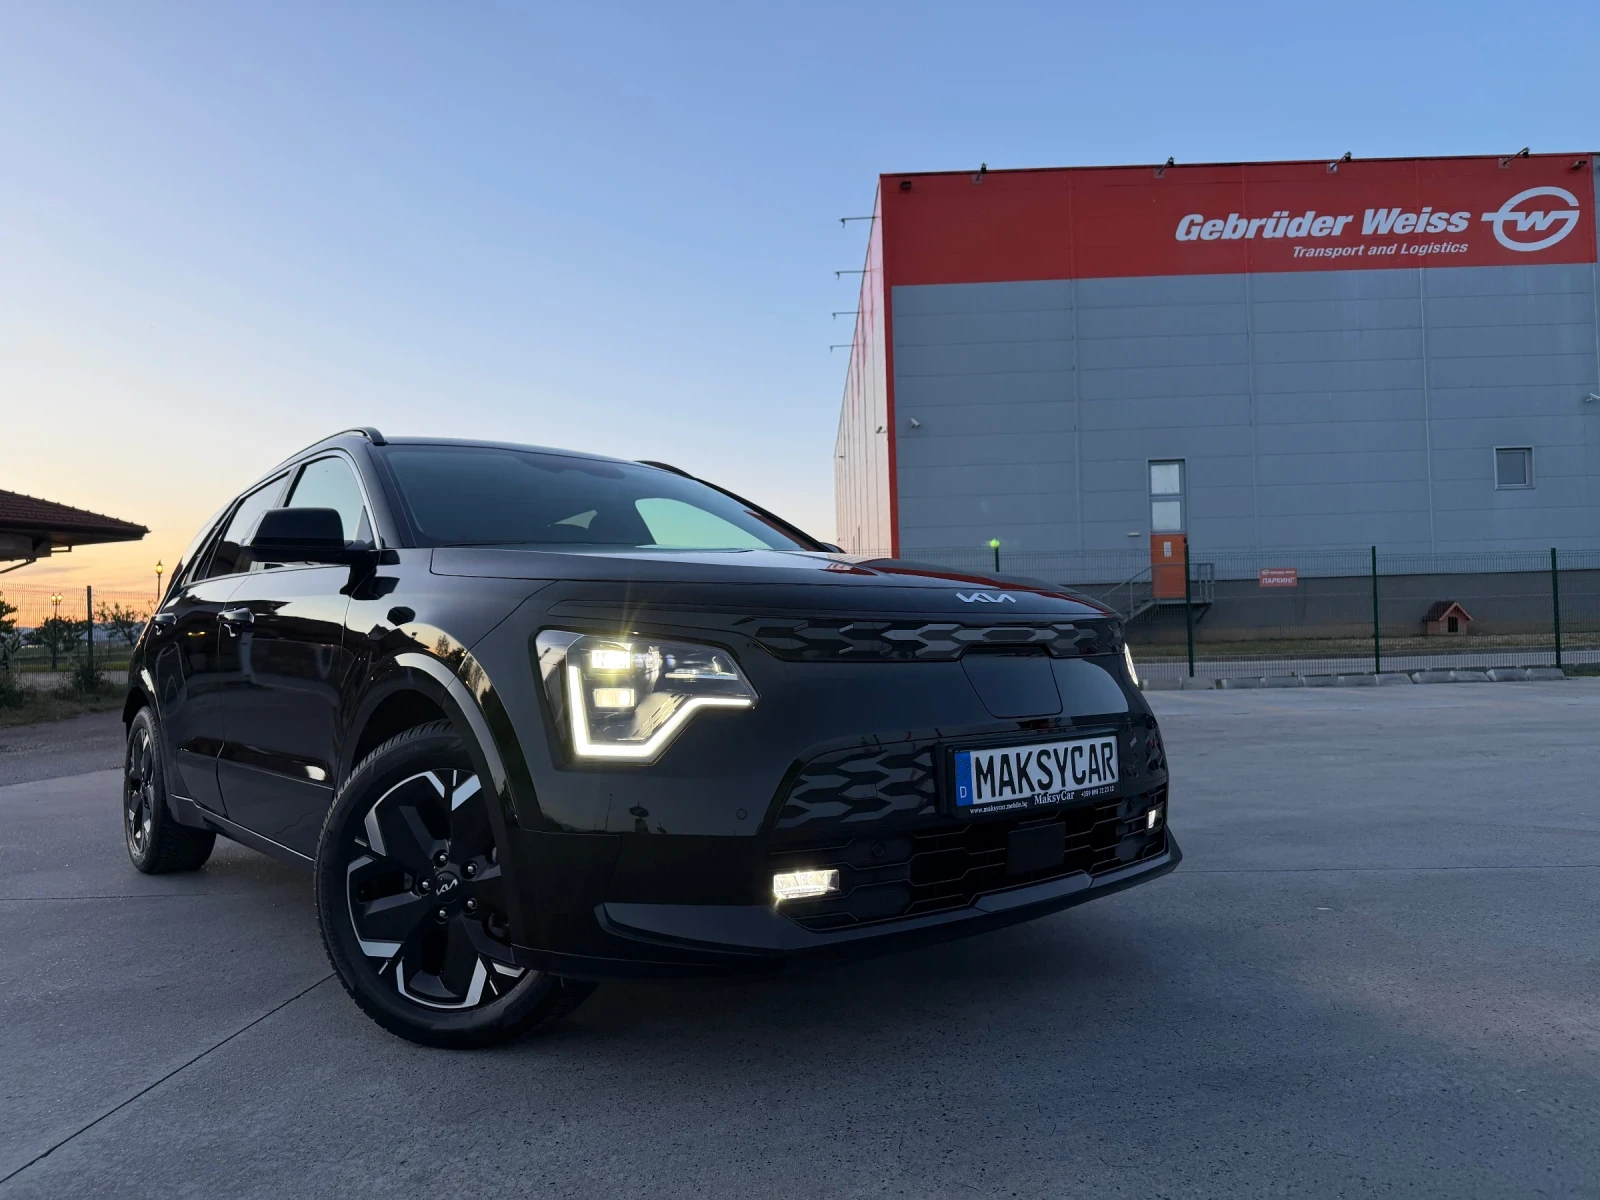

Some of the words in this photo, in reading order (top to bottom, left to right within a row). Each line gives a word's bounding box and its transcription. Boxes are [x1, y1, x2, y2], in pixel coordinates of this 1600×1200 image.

[1174, 210, 1352, 242] Gebrüder
[1361, 206, 1471, 235] Weiss
[1293, 243, 1365, 259] Transport
[1368, 242, 1397, 256] and
[1400, 240, 1468, 258] Logistics
[975, 742, 1115, 799] MAKSYCAR
[959, 786, 968, 798] D
[1033, 790, 1075, 805] MaksyCar
